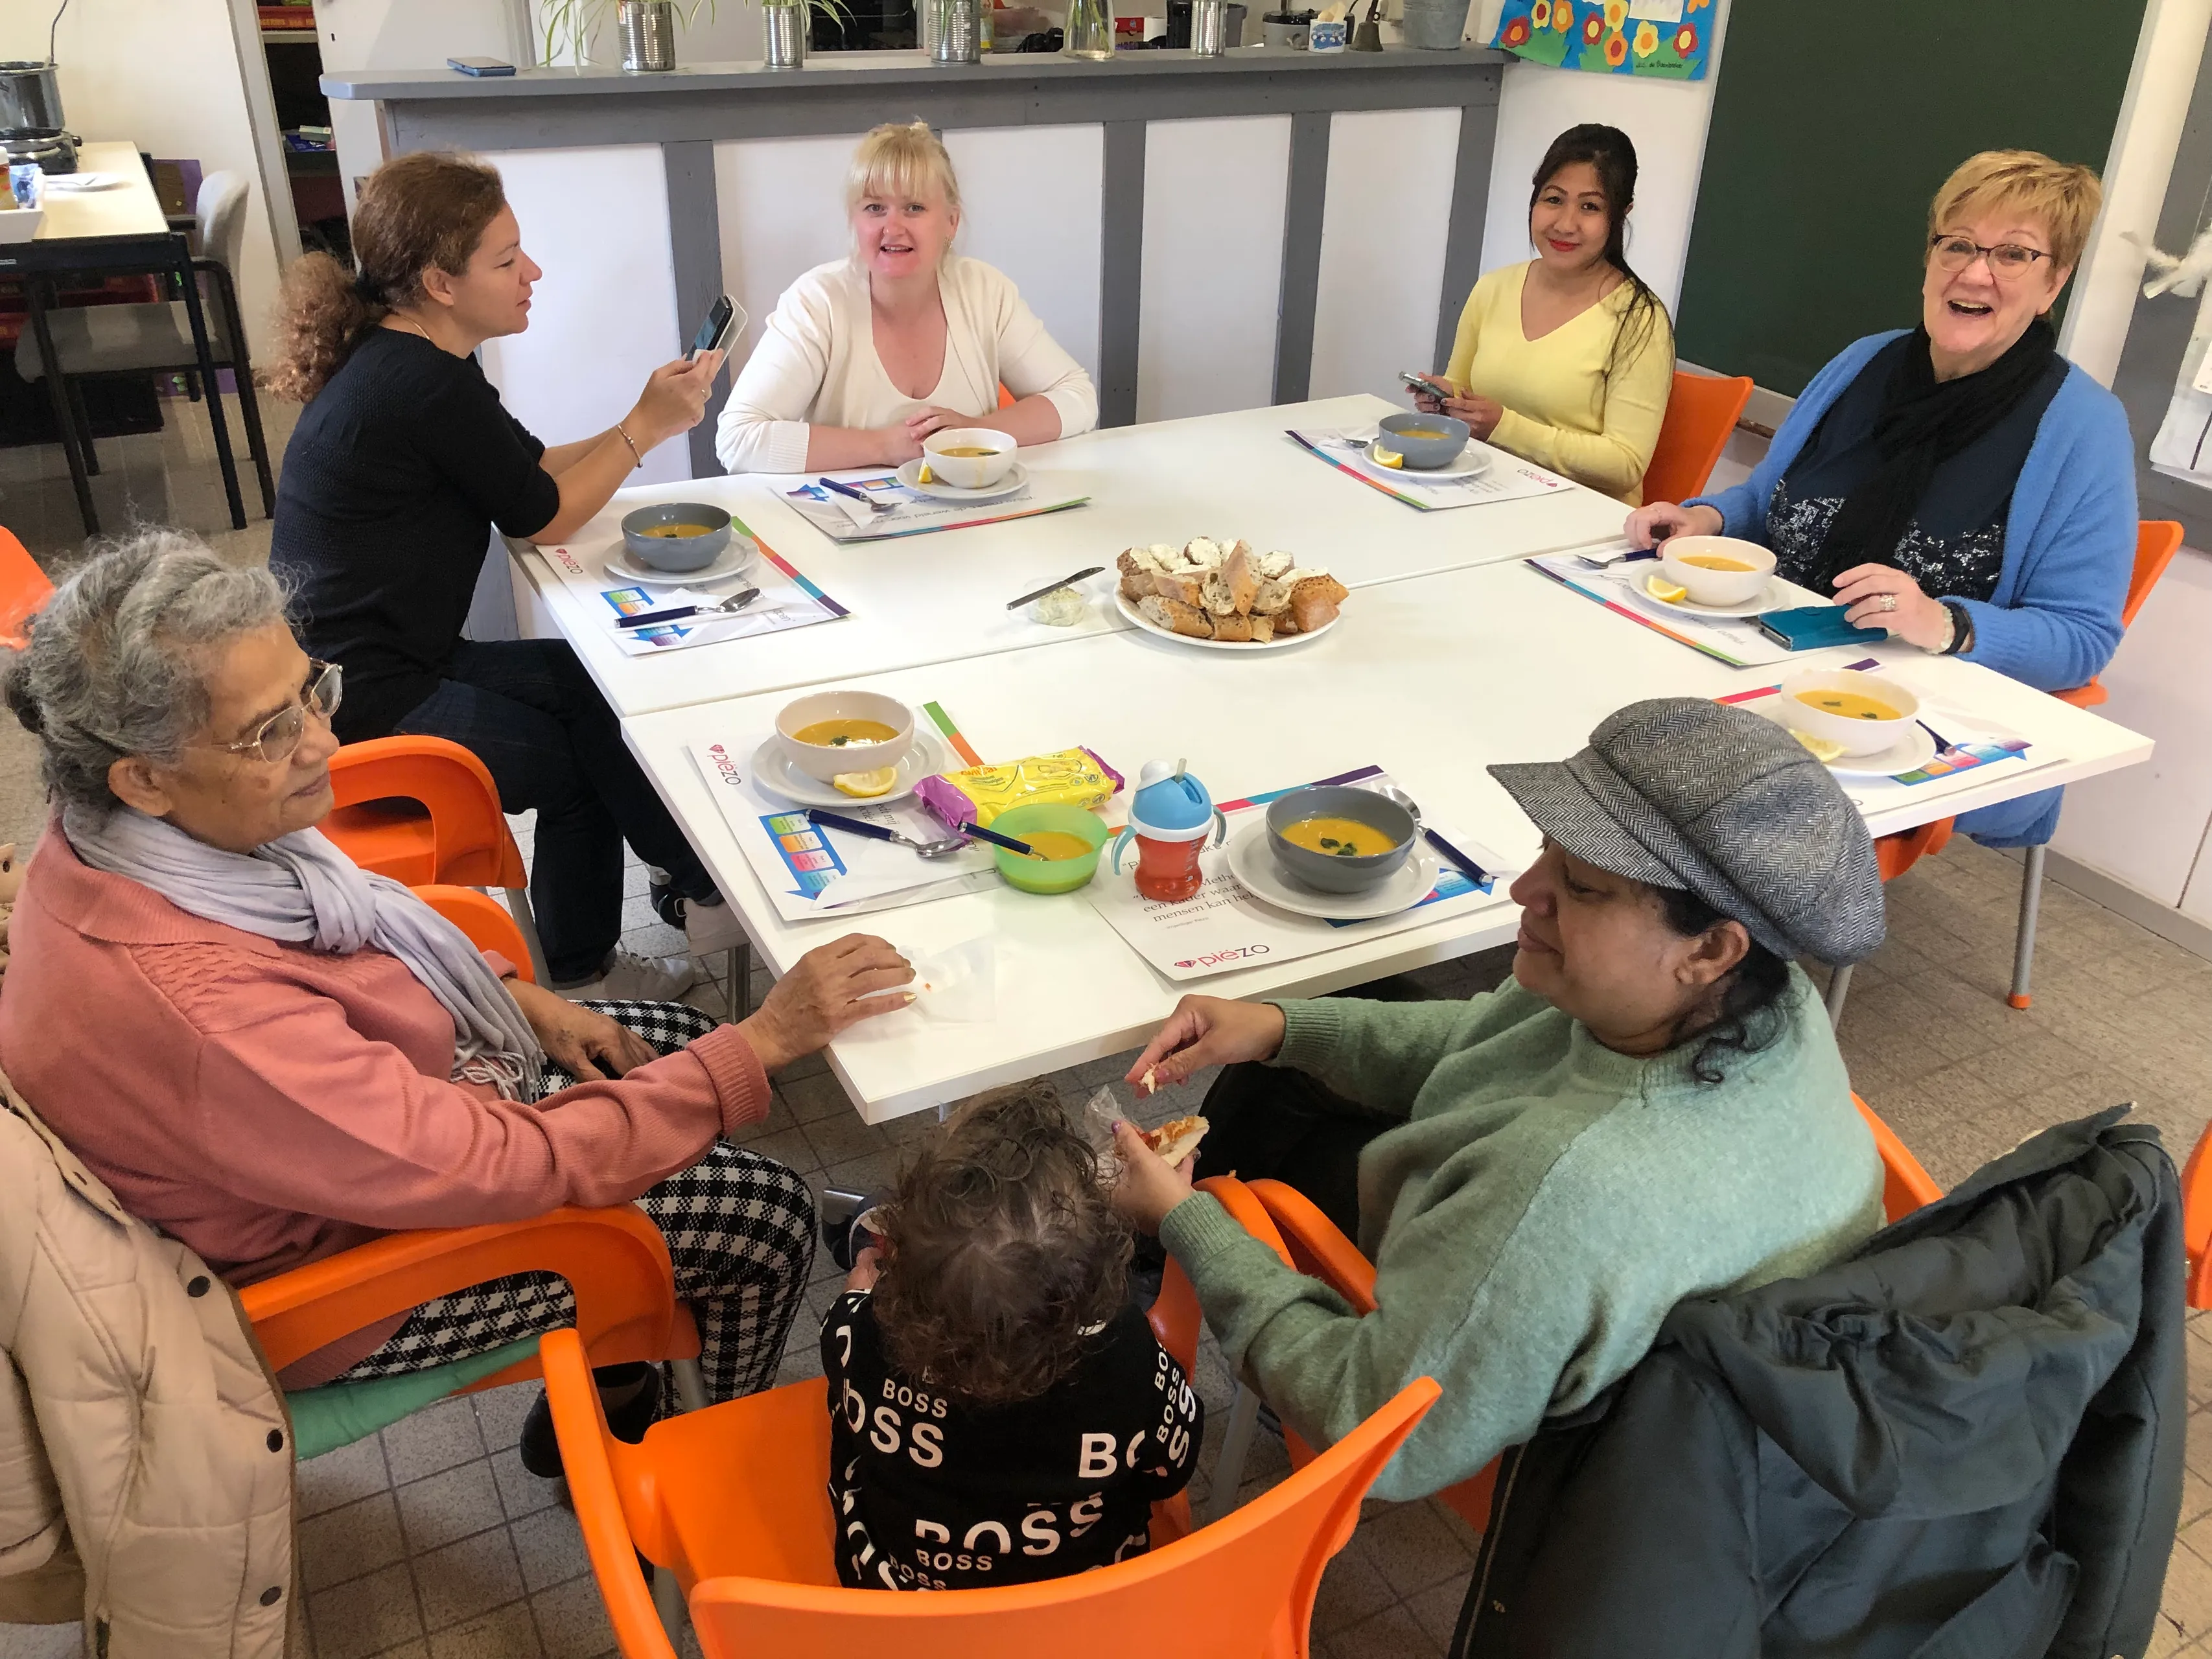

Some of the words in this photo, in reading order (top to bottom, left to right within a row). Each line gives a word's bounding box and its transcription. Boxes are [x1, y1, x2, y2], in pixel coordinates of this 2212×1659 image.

[706, 754, 741, 785] piëzo
[1143, 902, 1167, 912] een
[1209, 884, 1242, 896] waar
[1153, 905, 1204, 922] mensen
[1207, 898, 1231, 909] kan
[1198, 944, 1270, 968] piëzo
[883, 1378, 948, 1419] BOSS
[1156, 1367, 1180, 1444] BOSS
[843, 1378, 944, 1468] OSS
[916, 1549, 992, 1572] BOSS
